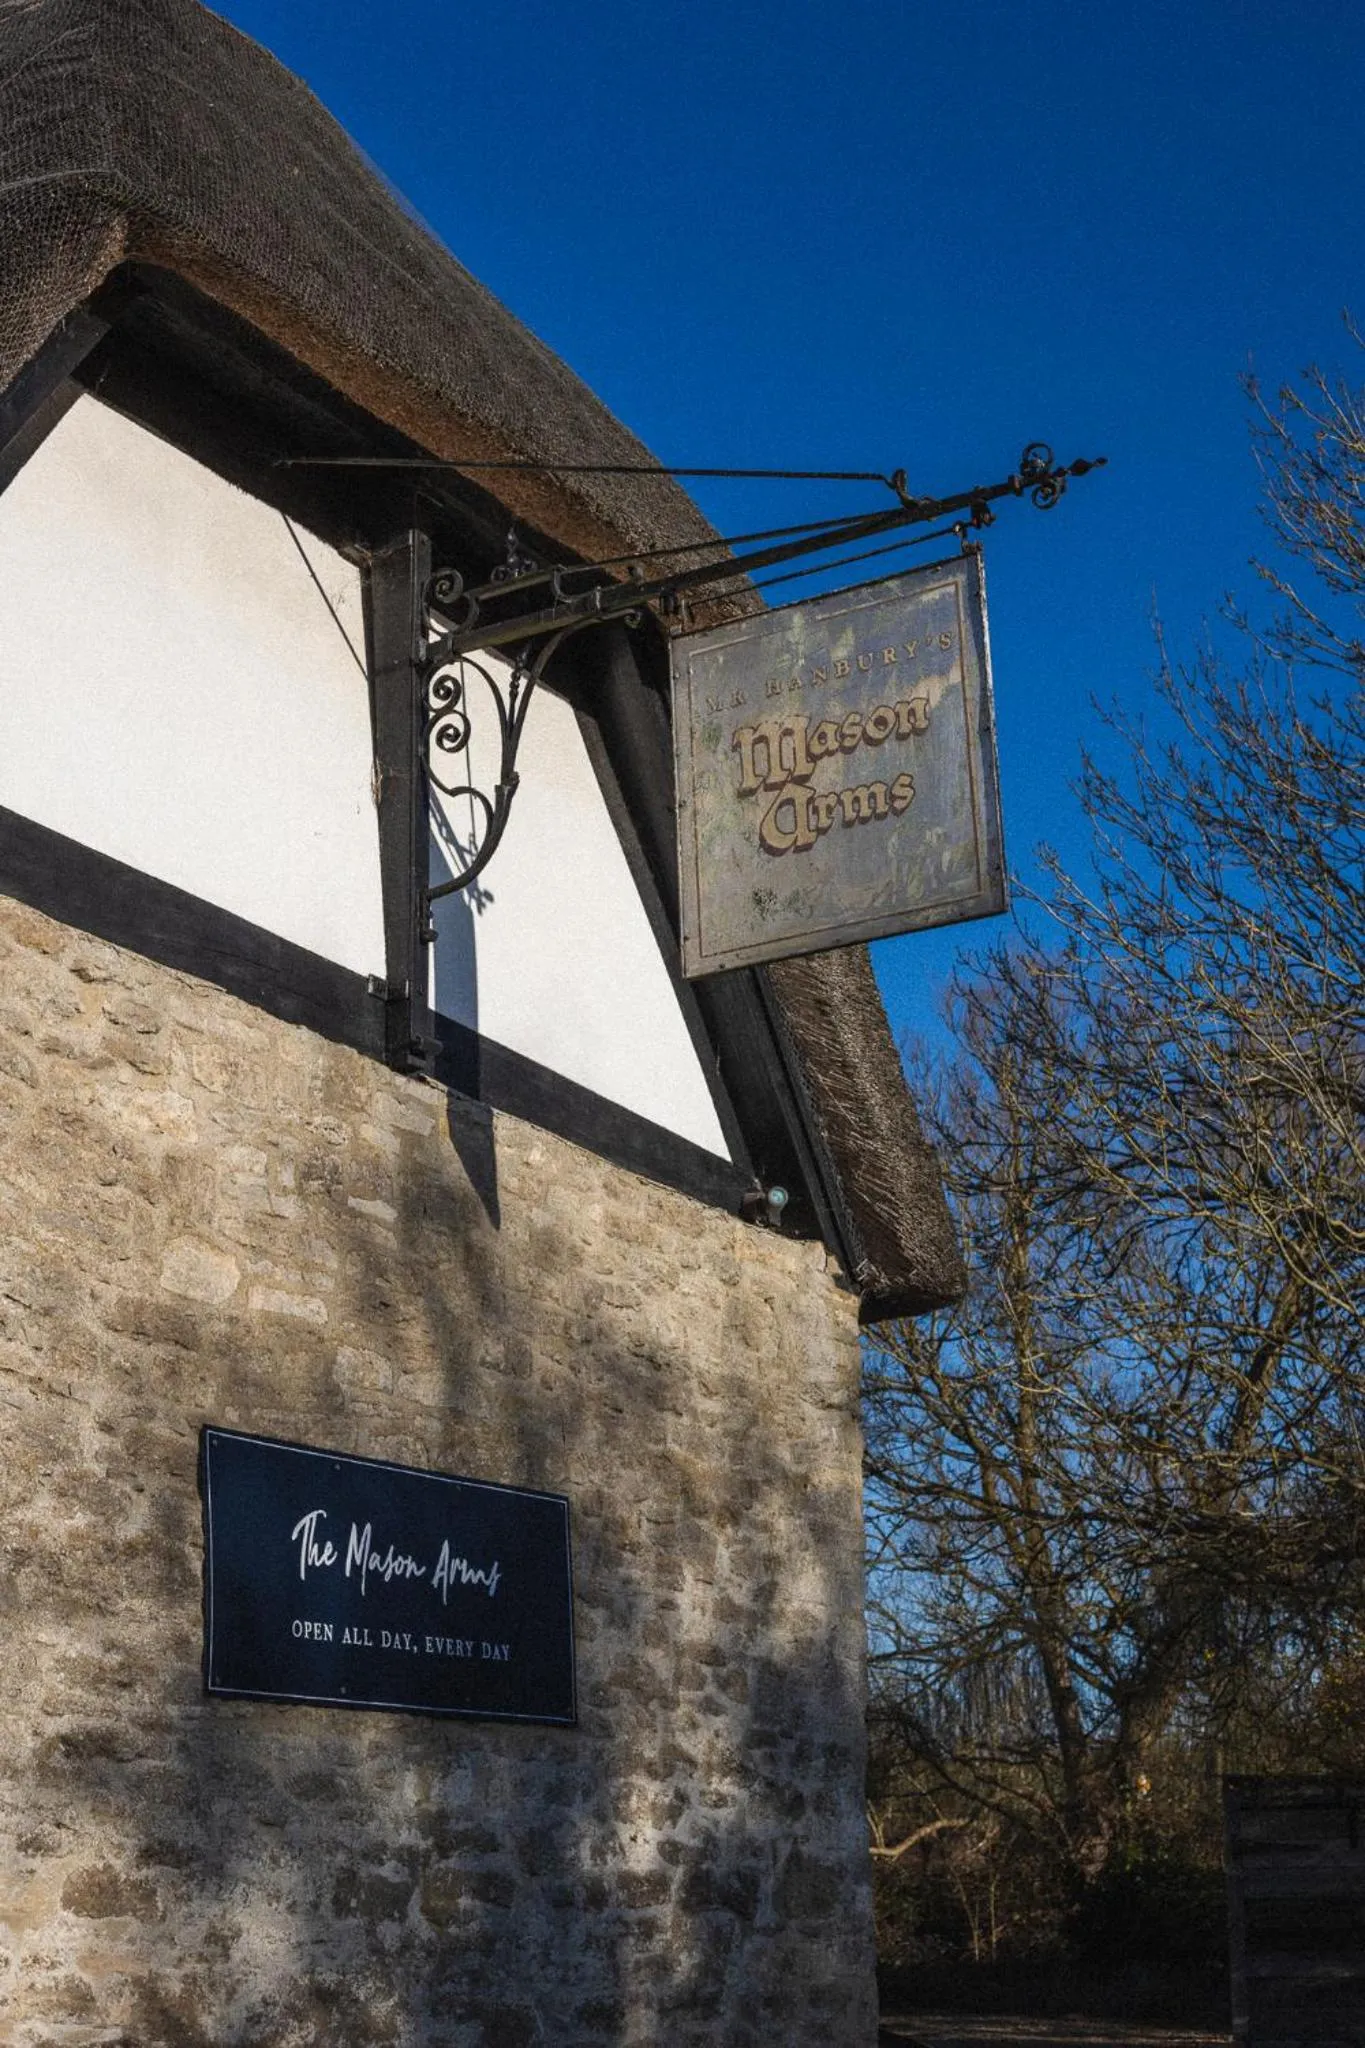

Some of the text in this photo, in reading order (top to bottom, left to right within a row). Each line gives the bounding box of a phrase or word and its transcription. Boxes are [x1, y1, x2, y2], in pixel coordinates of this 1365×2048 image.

[765, 632, 952, 698] HANBURY'S
[731, 697, 930, 797] Mason
[759, 773, 916, 857] Arms
[291, 1509, 502, 1605] The Mason Arms
[291, 1619, 512, 1661] OPEN ALL DAY, EVERY DAY
